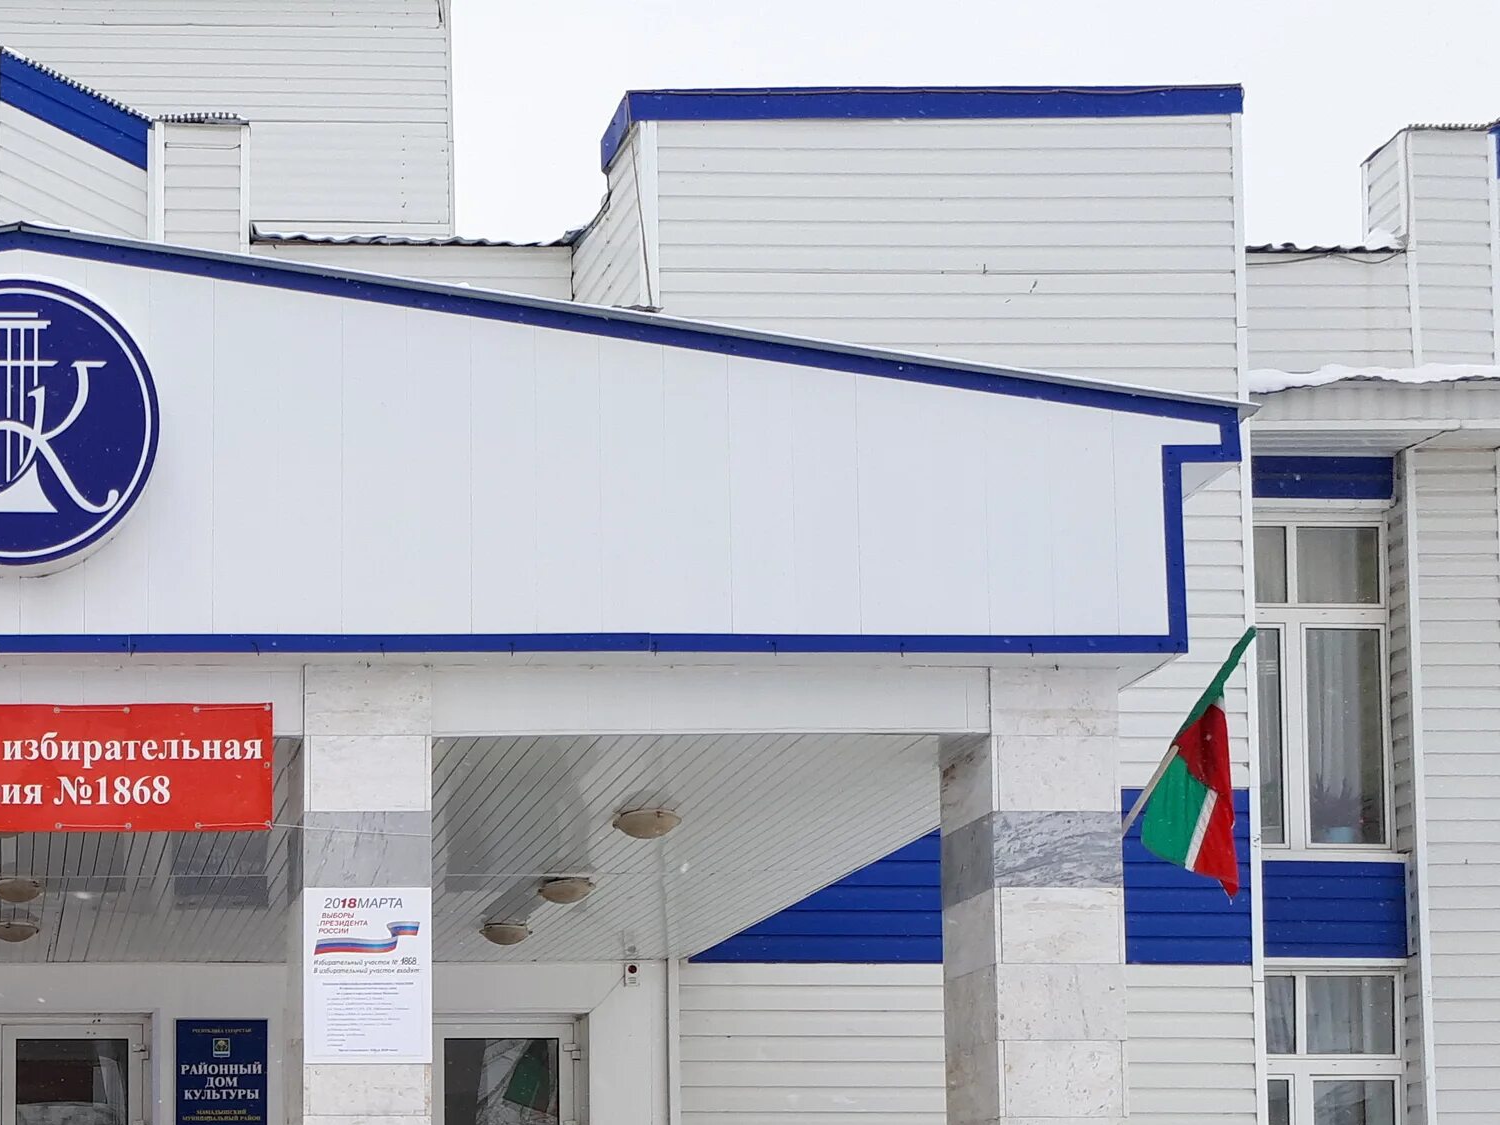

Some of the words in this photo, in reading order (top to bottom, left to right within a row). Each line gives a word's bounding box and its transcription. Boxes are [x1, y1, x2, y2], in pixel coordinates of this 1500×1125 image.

[2, 731, 263, 769] избирательная
[52, 775, 171, 807] №1868
[180, 1062, 263, 1075] РАЙОННЫЙ
[204, 1077, 238, 1088] ДОМ
[183, 1089, 260, 1101] КУЛЬТУРЫ
